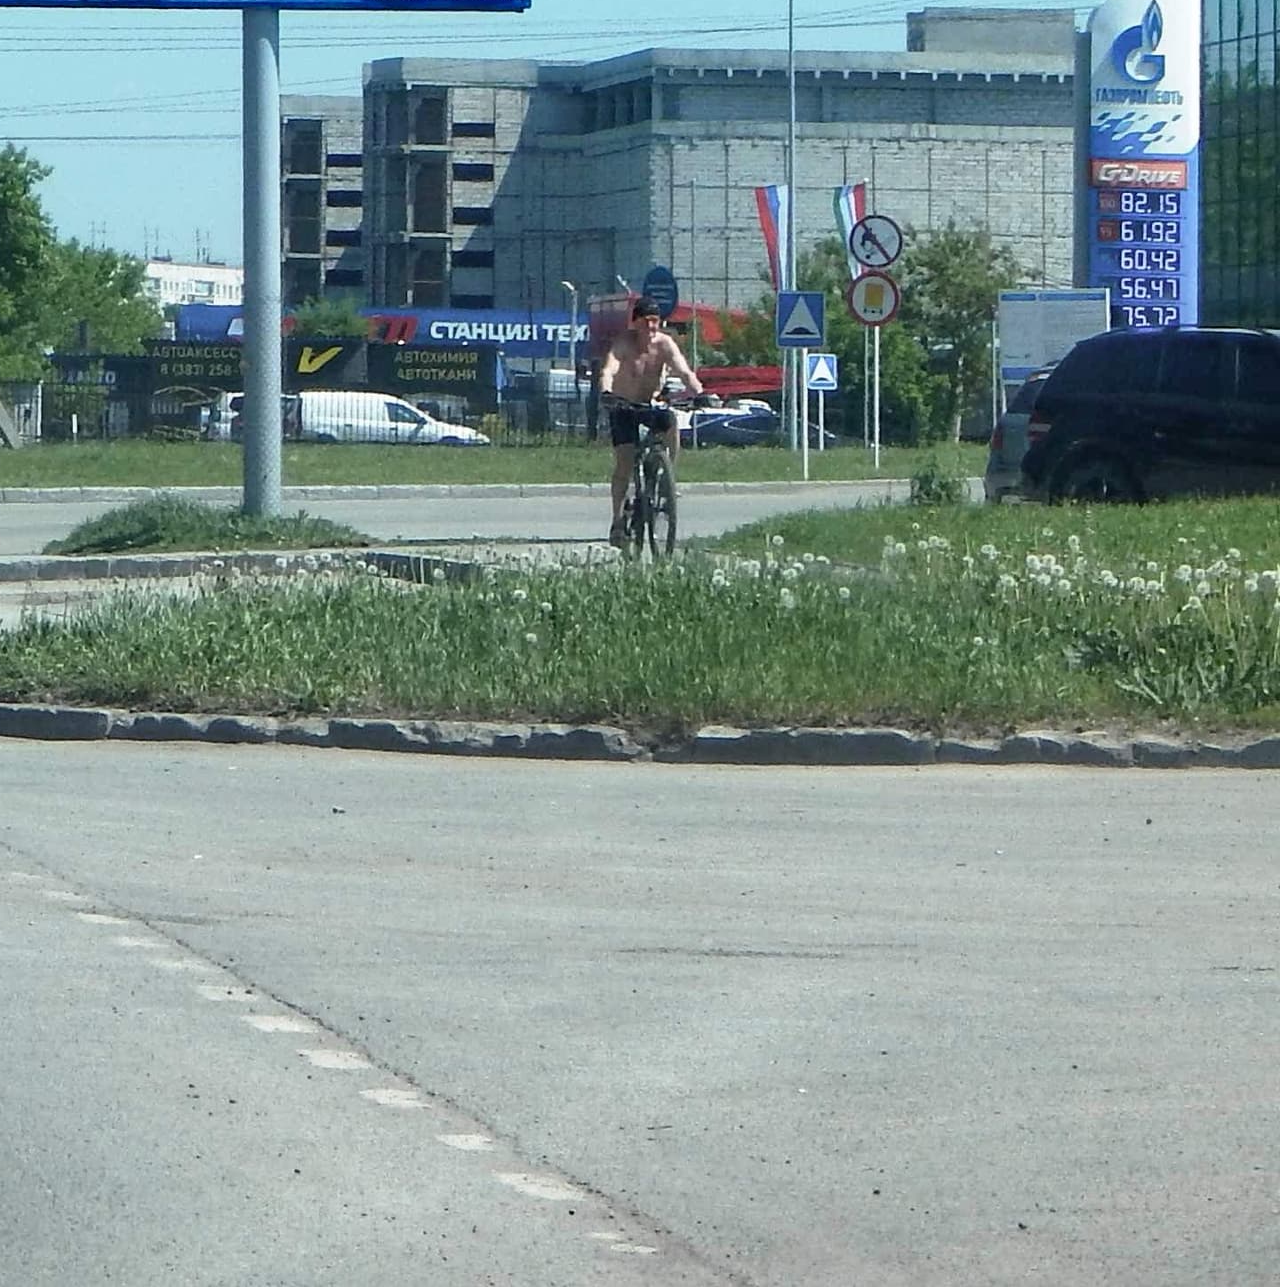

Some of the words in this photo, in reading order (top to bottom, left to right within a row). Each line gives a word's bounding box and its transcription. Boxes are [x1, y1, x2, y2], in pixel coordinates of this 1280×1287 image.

[1121, 192, 1178, 214] 82.15
[1121, 221, 1178, 243] 61.92
[1121, 249, 1178, 271] 60.42
[1121, 277, 1178, 299] 56.47
[429, 320, 537, 344] СТАНЦИЯ
[542, 323, 590, 342] ТЕХ
[152, 346, 242, 359] АВТОАКСЕСС
[394, 351, 479, 364] АВТОХИМИЯ
[396, 368, 477, 381] АВТОТКАНИ
